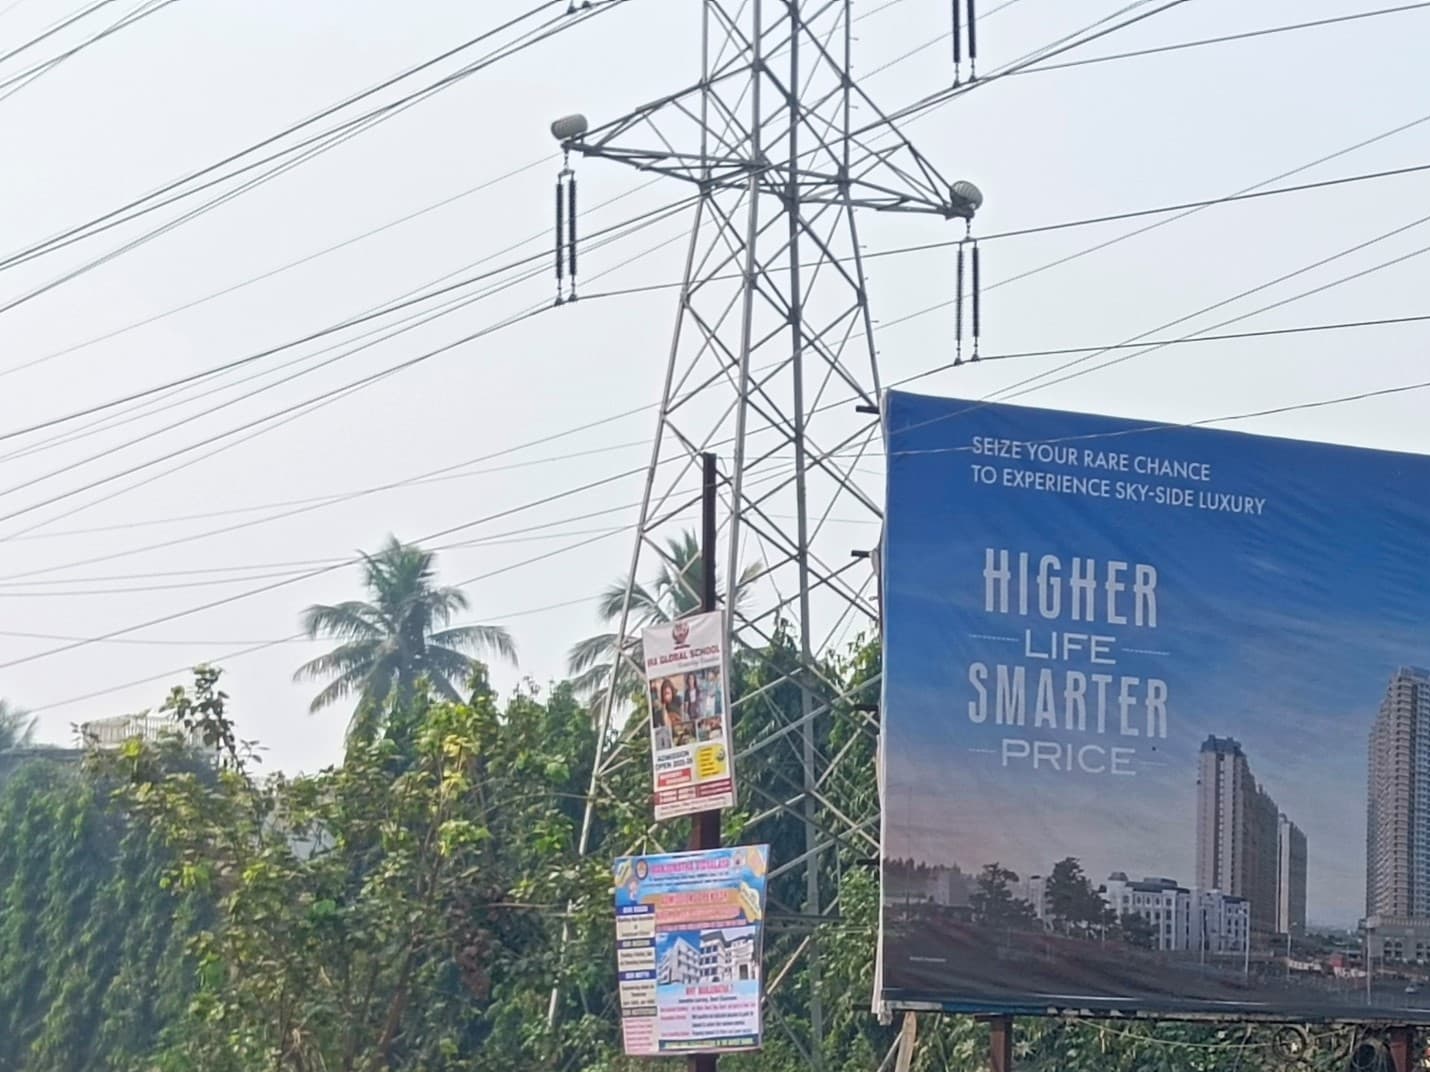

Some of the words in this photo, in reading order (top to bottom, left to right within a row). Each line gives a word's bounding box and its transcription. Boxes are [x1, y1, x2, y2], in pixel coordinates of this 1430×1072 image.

[972, 436, 1023, 460] SEIZE
[1027, 443, 1078, 468] YOUR
[1084, 449, 1129, 473] RARE
[1134, 454, 1211, 482] CHANCE
[972, 465, 998, 486] TO
[1003, 467, 1111, 498] EXPERIENCE
[1116, 480, 1194, 508] SKY-SIDE
[1199, 490, 1265, 516] LUXURY
[983, 548, 1158, 629] HIGHER
[689, 645, 720, 658] SCHOOL
[1025, 629, 1117, 665] LIFE
[968, 663, 1168, 739] SMARTER
[1002, 738, 1138, 776] PRICE
